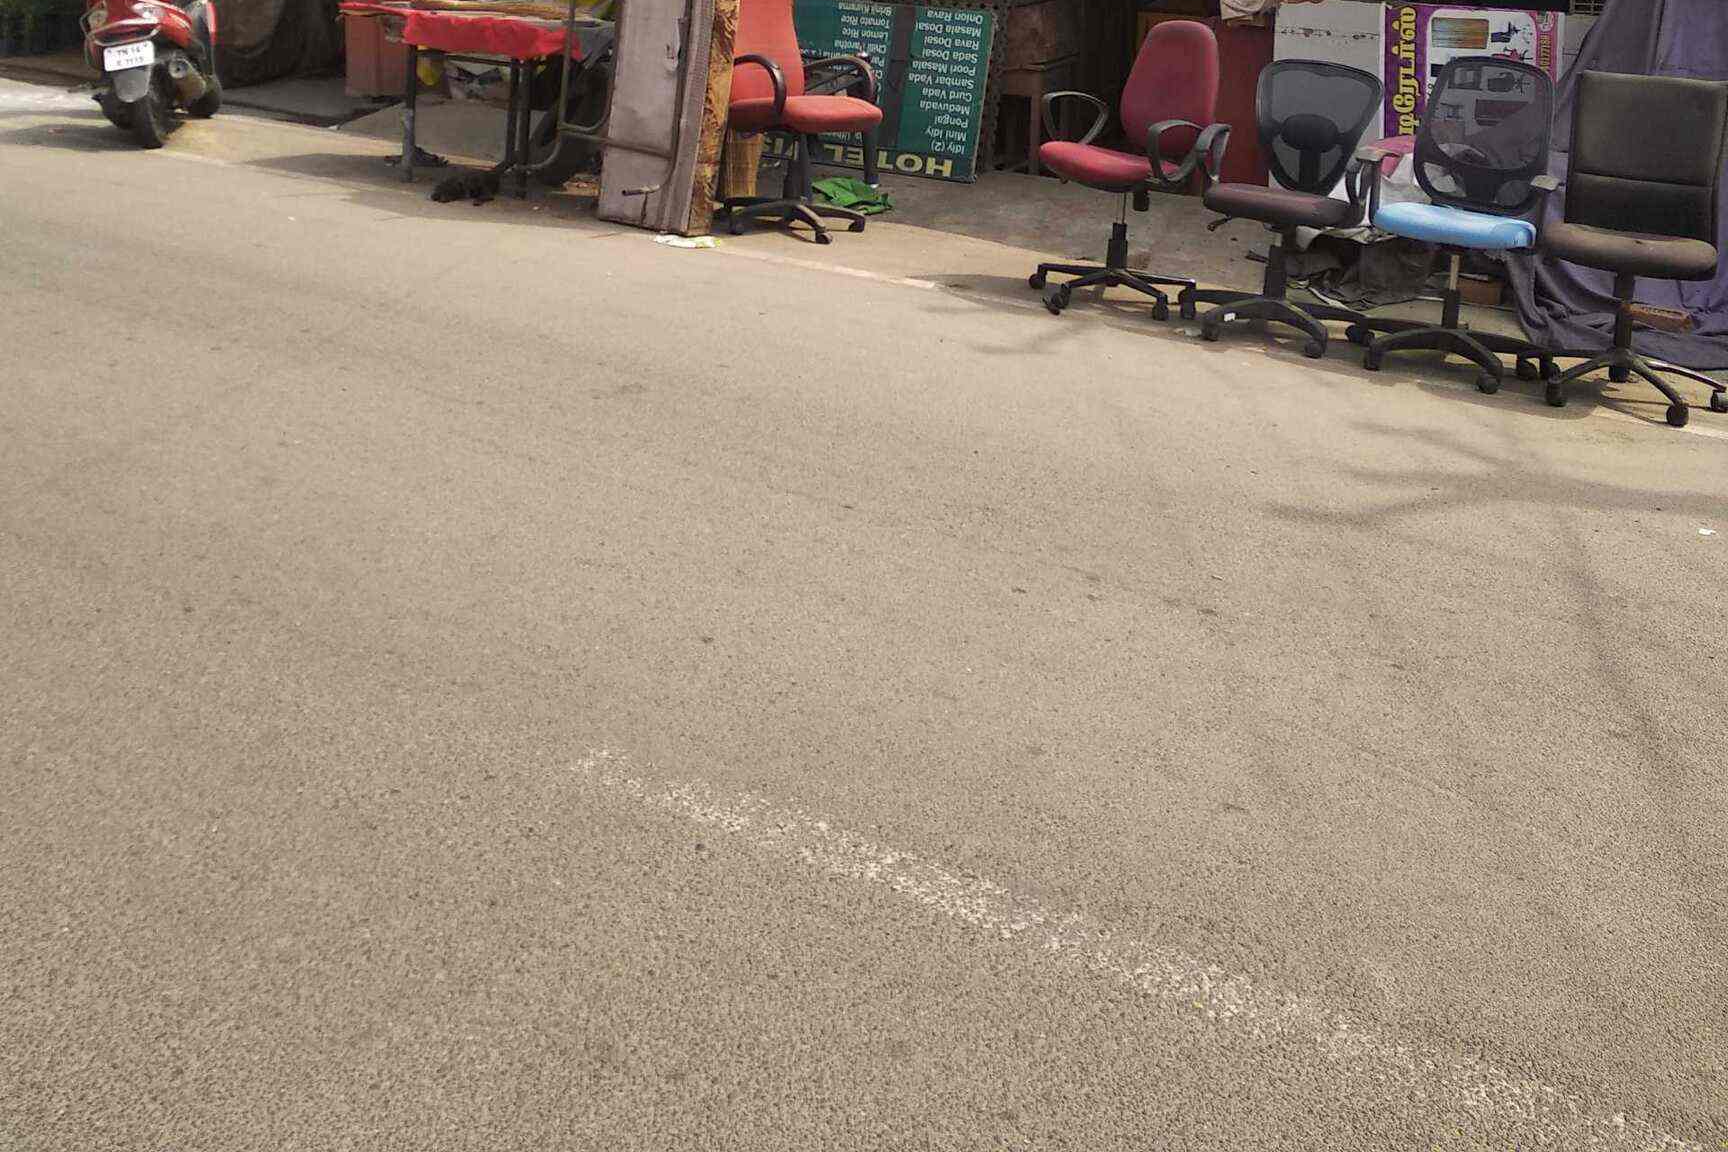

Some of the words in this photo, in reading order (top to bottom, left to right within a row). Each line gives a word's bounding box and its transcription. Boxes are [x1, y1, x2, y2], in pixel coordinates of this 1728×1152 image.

[840, 14, 859, 26] Rice
[926, 9, 952, 21] Rava
[955, 13, 983, 25] Onion
[859, 16, 890, 29] Tomato
[915, 20, 944, 34] Dosai
[841, 26, 859, 39] Rice
[861, 29, 889, 42] Lemon
[945, 25, 981, 38] Masala
[924, 35, 952, 48] Dosai
[954, 39, 980, 51] Rava
[922, 47, 950, 61] Dosai
[953, 53, 978, 65] Sada
[912, 60, 948, 74] Masala
[950, 65, 976, 77] Poori
[1392, 6, 1421, 136] டிரேடர்ஸ்
[908, 72, 933, 86] Vada
[935, 75, 975, 90] Sambar
[922, 87, 947, 100] Vada
[949, 91, 973, 103] Curd
[920, 99, 971, 116] Meduvada
[934, 114, 969, 129] Pongal
[926, 126, 943, 139] Idly
[945, 130, 967, 142] Mini
[930, 140, 946, 152] (2)
[948, 143, 965, 155] Idly
